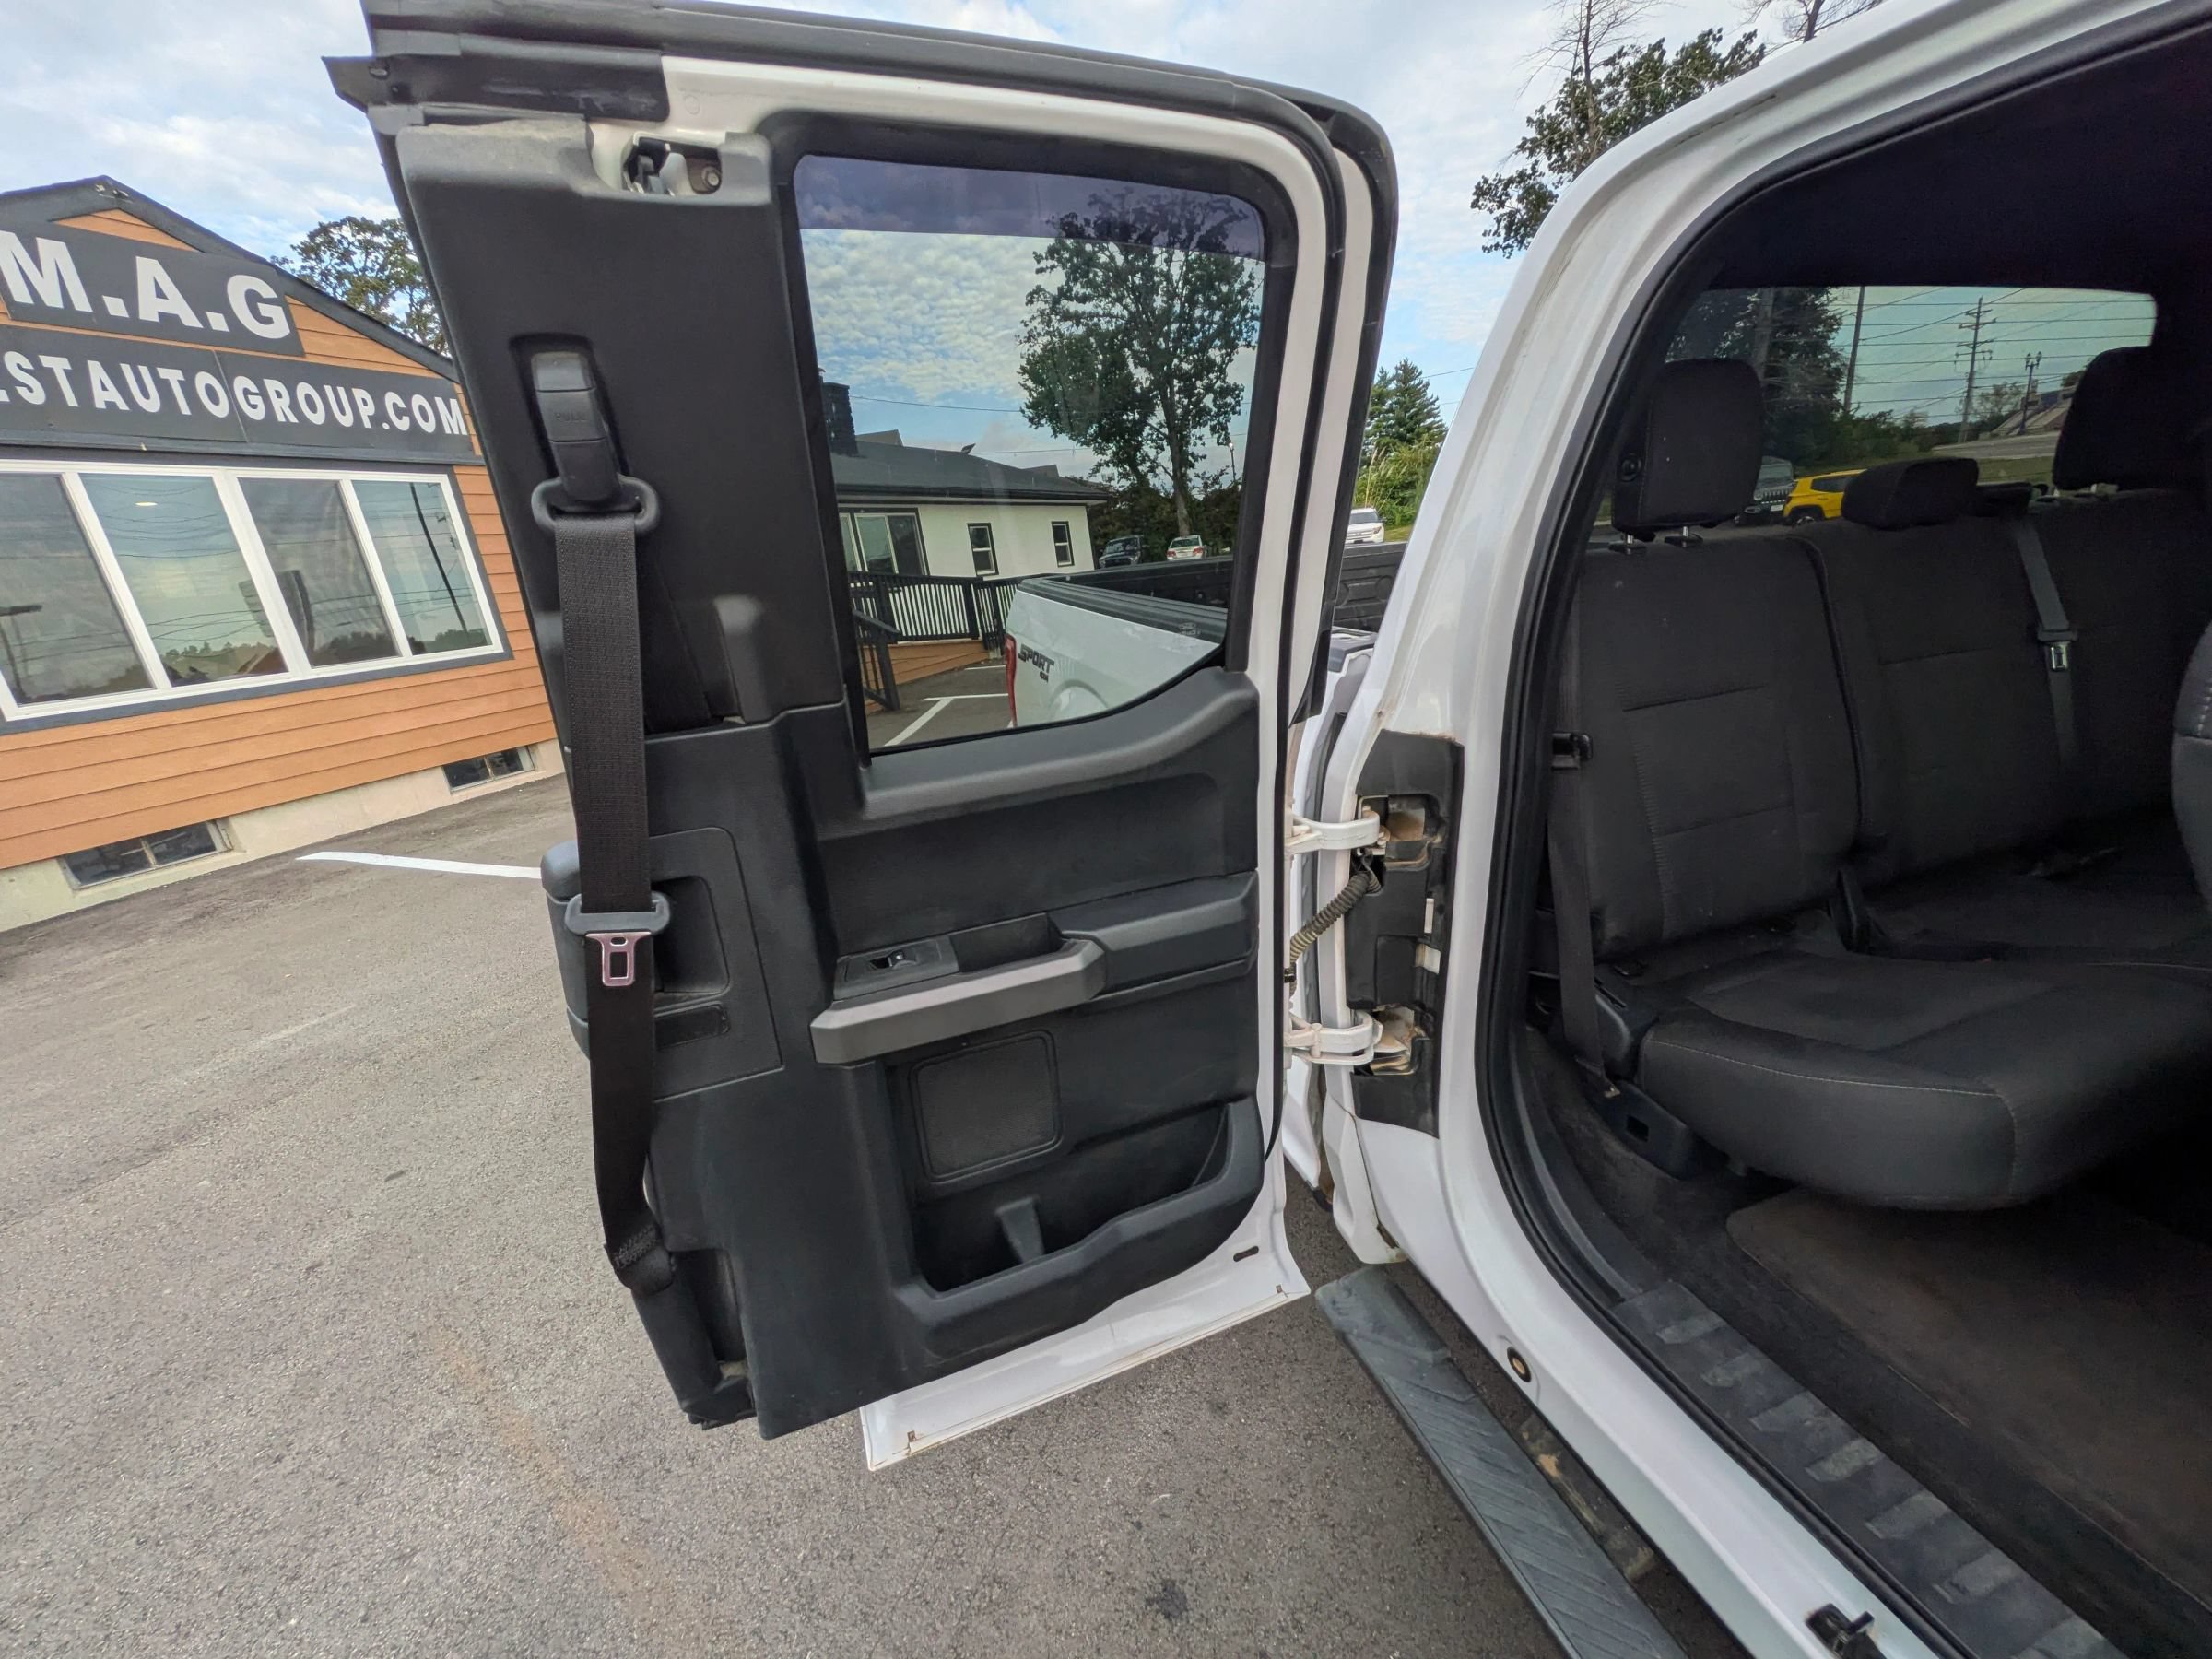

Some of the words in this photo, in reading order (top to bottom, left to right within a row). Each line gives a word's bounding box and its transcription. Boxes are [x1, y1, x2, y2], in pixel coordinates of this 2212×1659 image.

[0, 231, 290, 338] M.A.G
[0, 351, 467, 435] STAUTOGROUP.COM
[1018, 643, 1054, 673] SPORT
